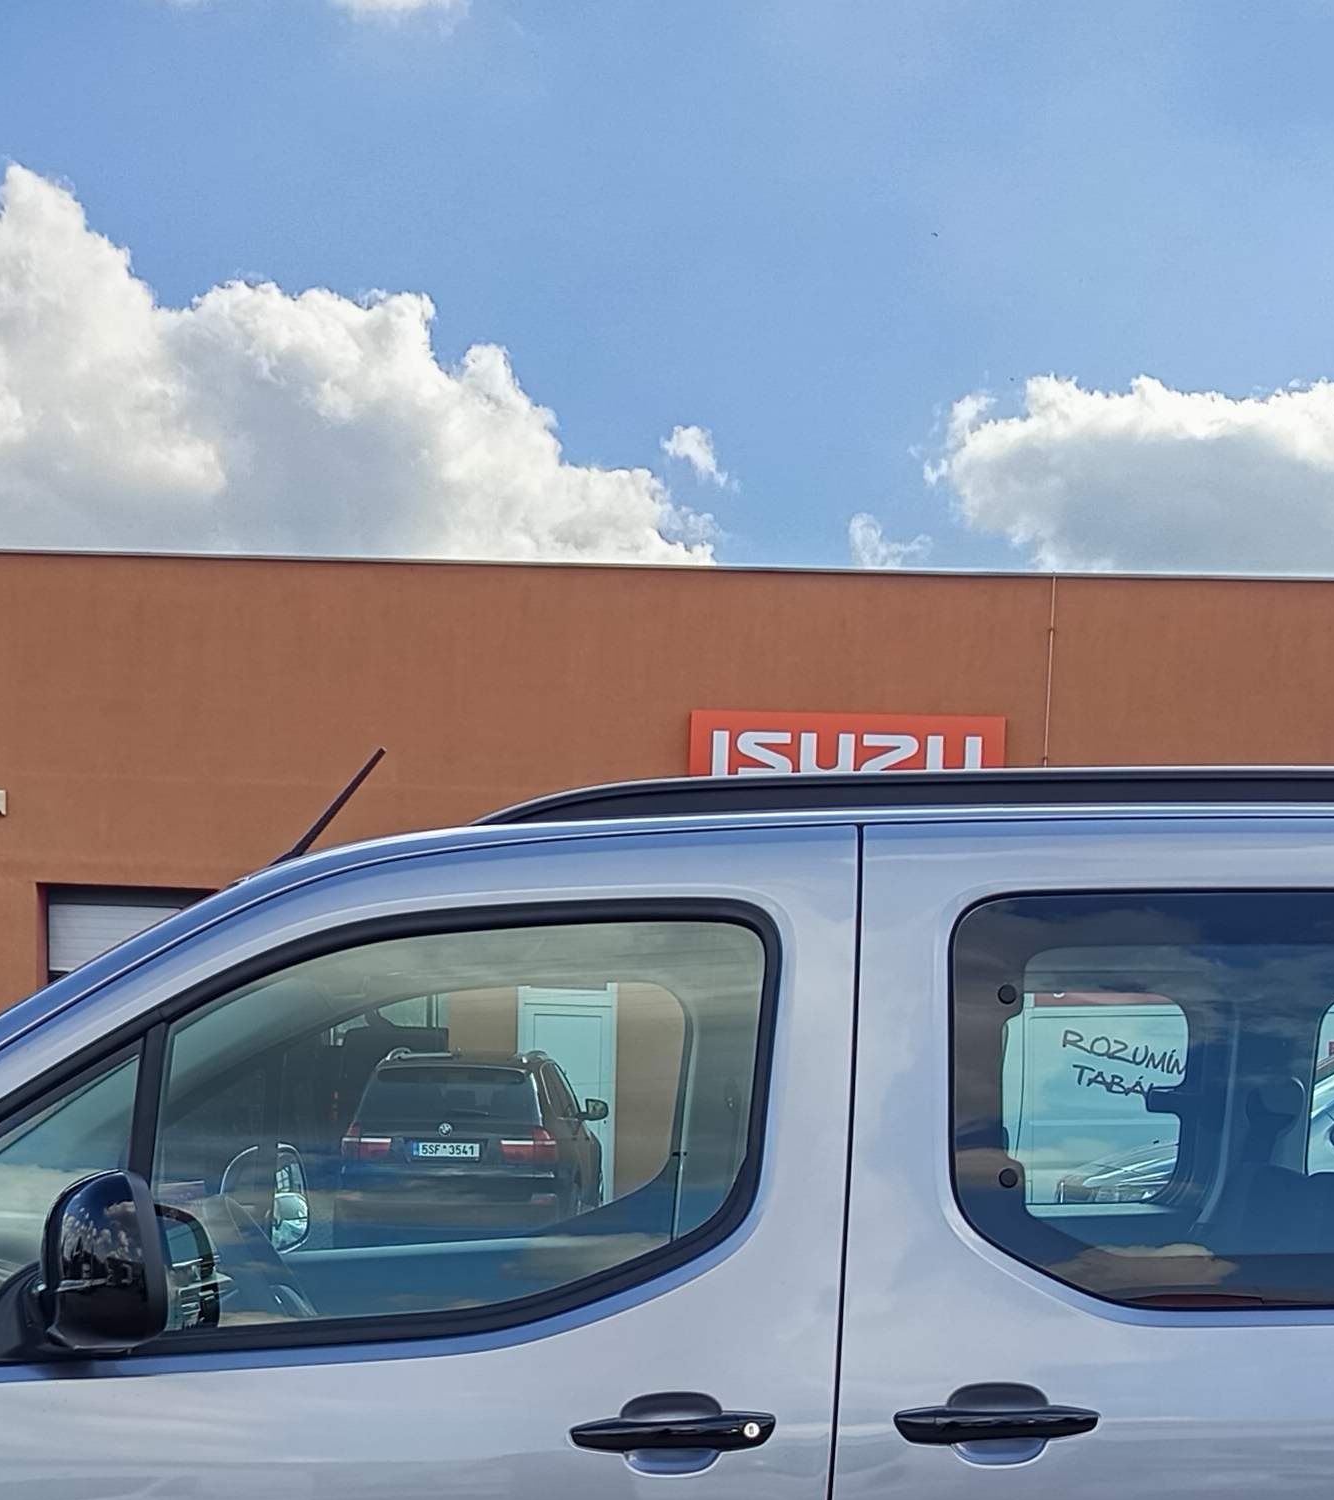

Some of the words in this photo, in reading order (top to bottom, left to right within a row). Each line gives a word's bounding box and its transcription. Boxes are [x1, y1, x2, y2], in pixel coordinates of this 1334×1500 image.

[711, 730, 983, 776] ISUZU
[1072, 1064, 1154, 1096] TABÁ
[421, 1144, 441, 1155] 5SF
[448, 1144, 474, 1156] 3541
